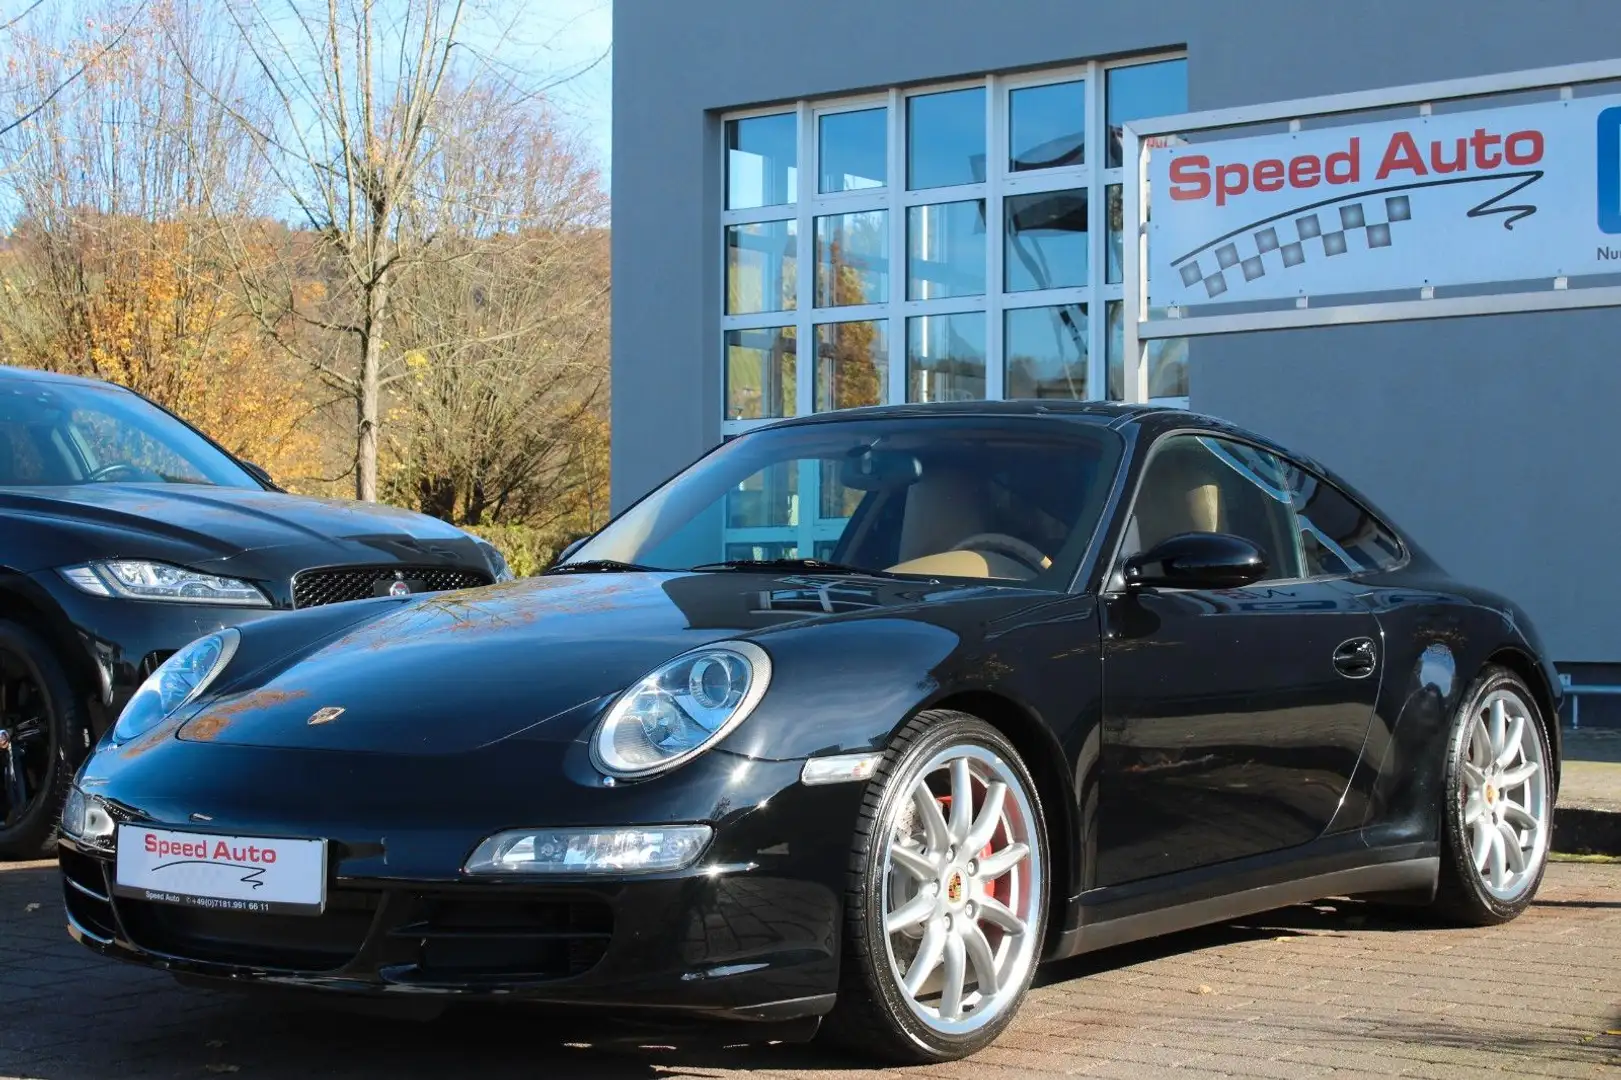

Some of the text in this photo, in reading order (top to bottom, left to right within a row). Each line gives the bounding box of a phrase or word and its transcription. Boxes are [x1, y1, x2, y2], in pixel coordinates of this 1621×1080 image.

[1169, 129, 1544, 206] Speed Auto
[1597, 246, 1621, 260] Nu
[145, 834, 277, 864] Speed Auto
[145, 890, 165, 901] Speed
[165, 893, 180, 903] Auto
[260, 903, 269, 911] 11
